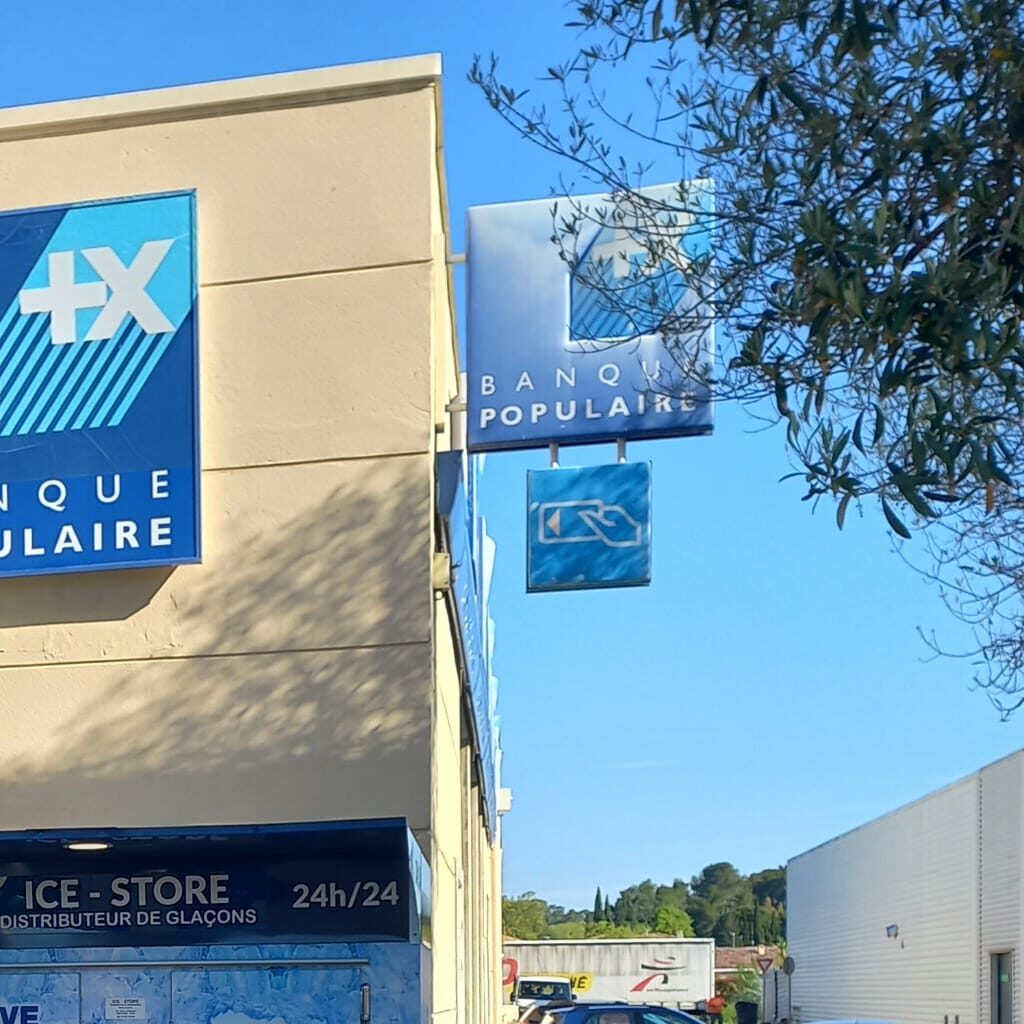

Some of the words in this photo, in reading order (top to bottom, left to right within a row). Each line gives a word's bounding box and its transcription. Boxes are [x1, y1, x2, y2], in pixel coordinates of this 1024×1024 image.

[480, 391, 697, 428] POPULAIRE
[25, 879, 80, 910] ICE
[110, 874, 230, 907] STORE
[292, 881, 400, 909] 24h/24
[0, 911, 132, 929] DISTRIBUTEUR
[136, 911, 161, 926] DE
[166, 909, 257, 928] GLAÇONS
